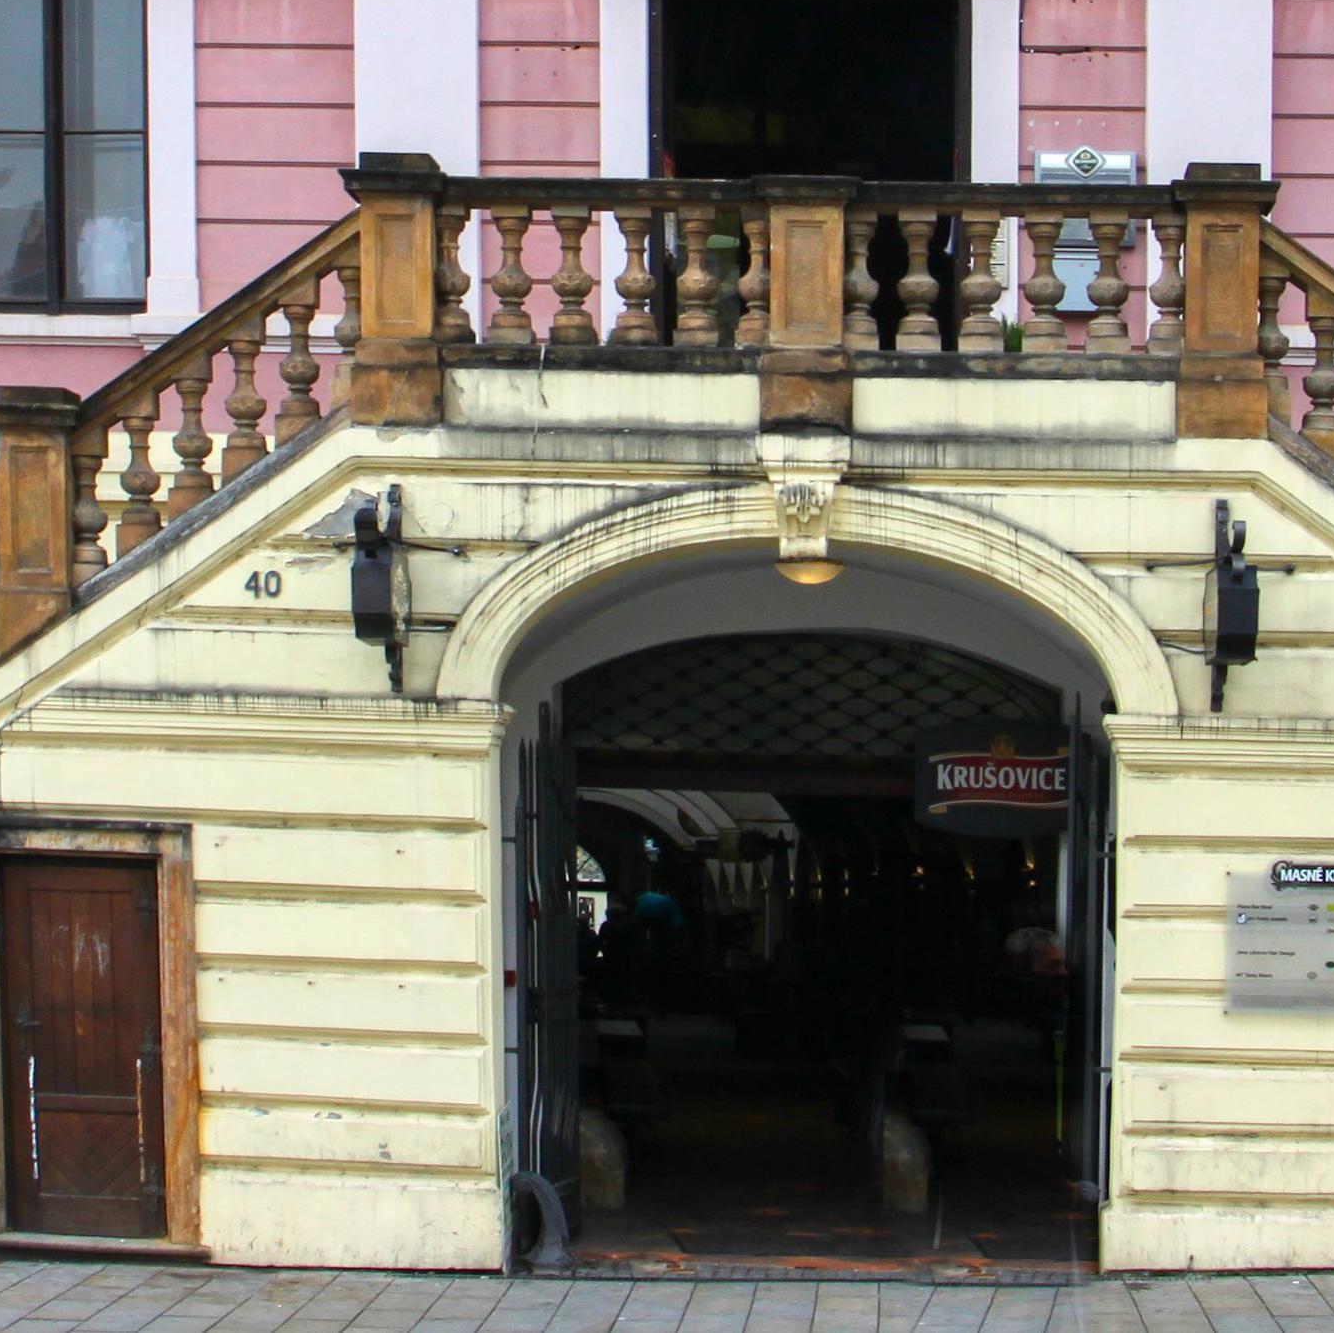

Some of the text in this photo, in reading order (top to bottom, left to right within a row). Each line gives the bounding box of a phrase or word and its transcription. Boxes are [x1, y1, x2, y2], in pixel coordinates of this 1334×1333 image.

[244, 570, 282, 599] 40
[937, 761, 1066, 790] KRUŠOVICE
[1280, 867, 1323, 882] MASNÉ
